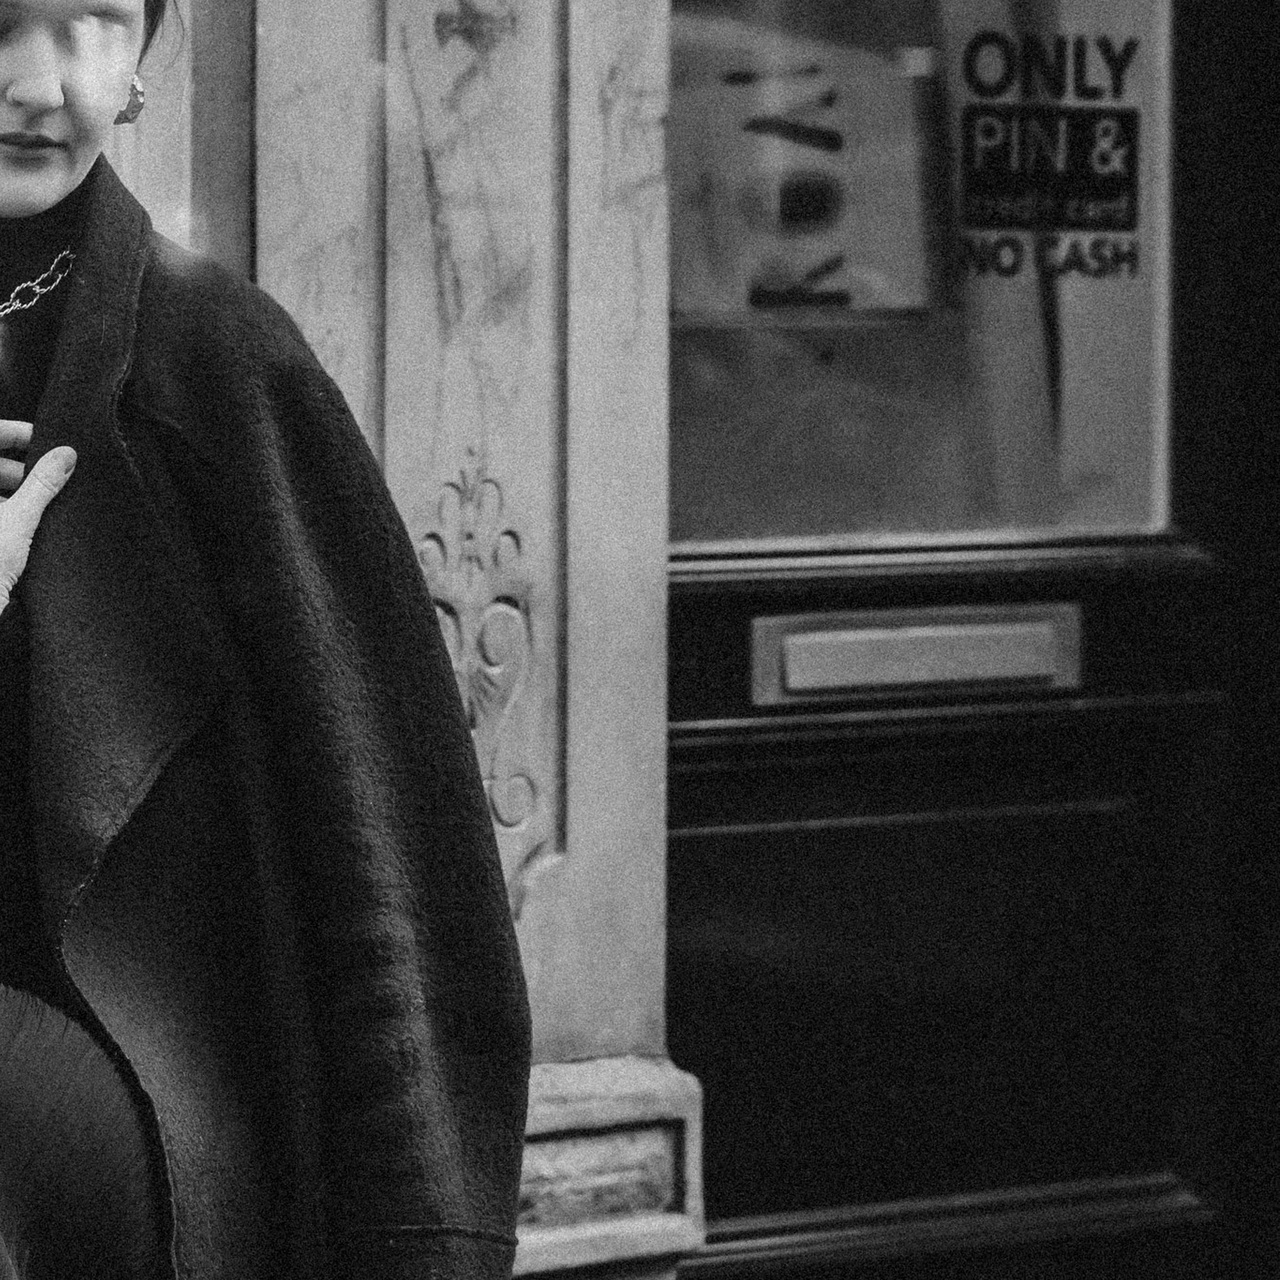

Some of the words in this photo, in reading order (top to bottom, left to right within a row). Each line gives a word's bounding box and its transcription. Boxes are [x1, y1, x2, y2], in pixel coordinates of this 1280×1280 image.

[963, 30, 1141, 100] ONLY
[974, 117, 1068, 173] PIN
[1090, 118, 1128, 174] &
[963, 236, 1024, 277] NO
